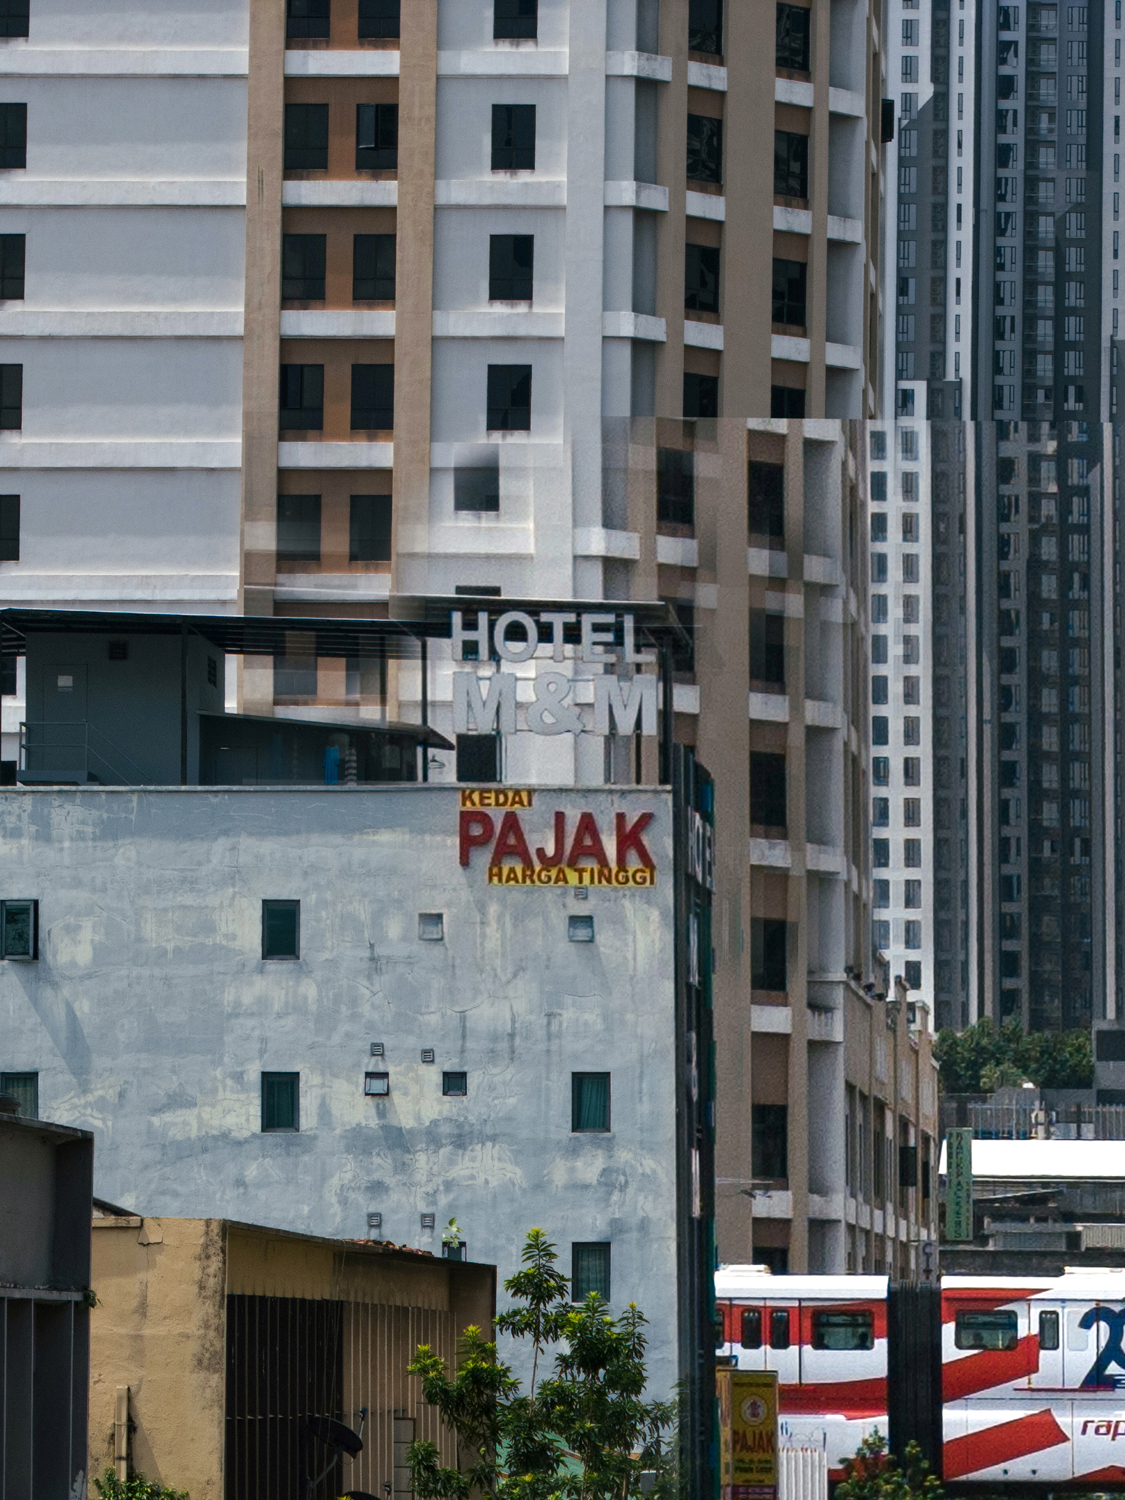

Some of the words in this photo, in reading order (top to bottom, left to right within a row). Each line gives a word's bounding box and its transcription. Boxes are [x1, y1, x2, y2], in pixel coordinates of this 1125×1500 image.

[452, 610, 657, 663] HOTEL
[452, 671, 658, 737] M&M
[460, 789, 534, 807] KEDAI
[459, 810, 655, 869] PAJAK
[488, 866, 568, 885] HARGA
[573, 866, 656, 885] TINGGI
